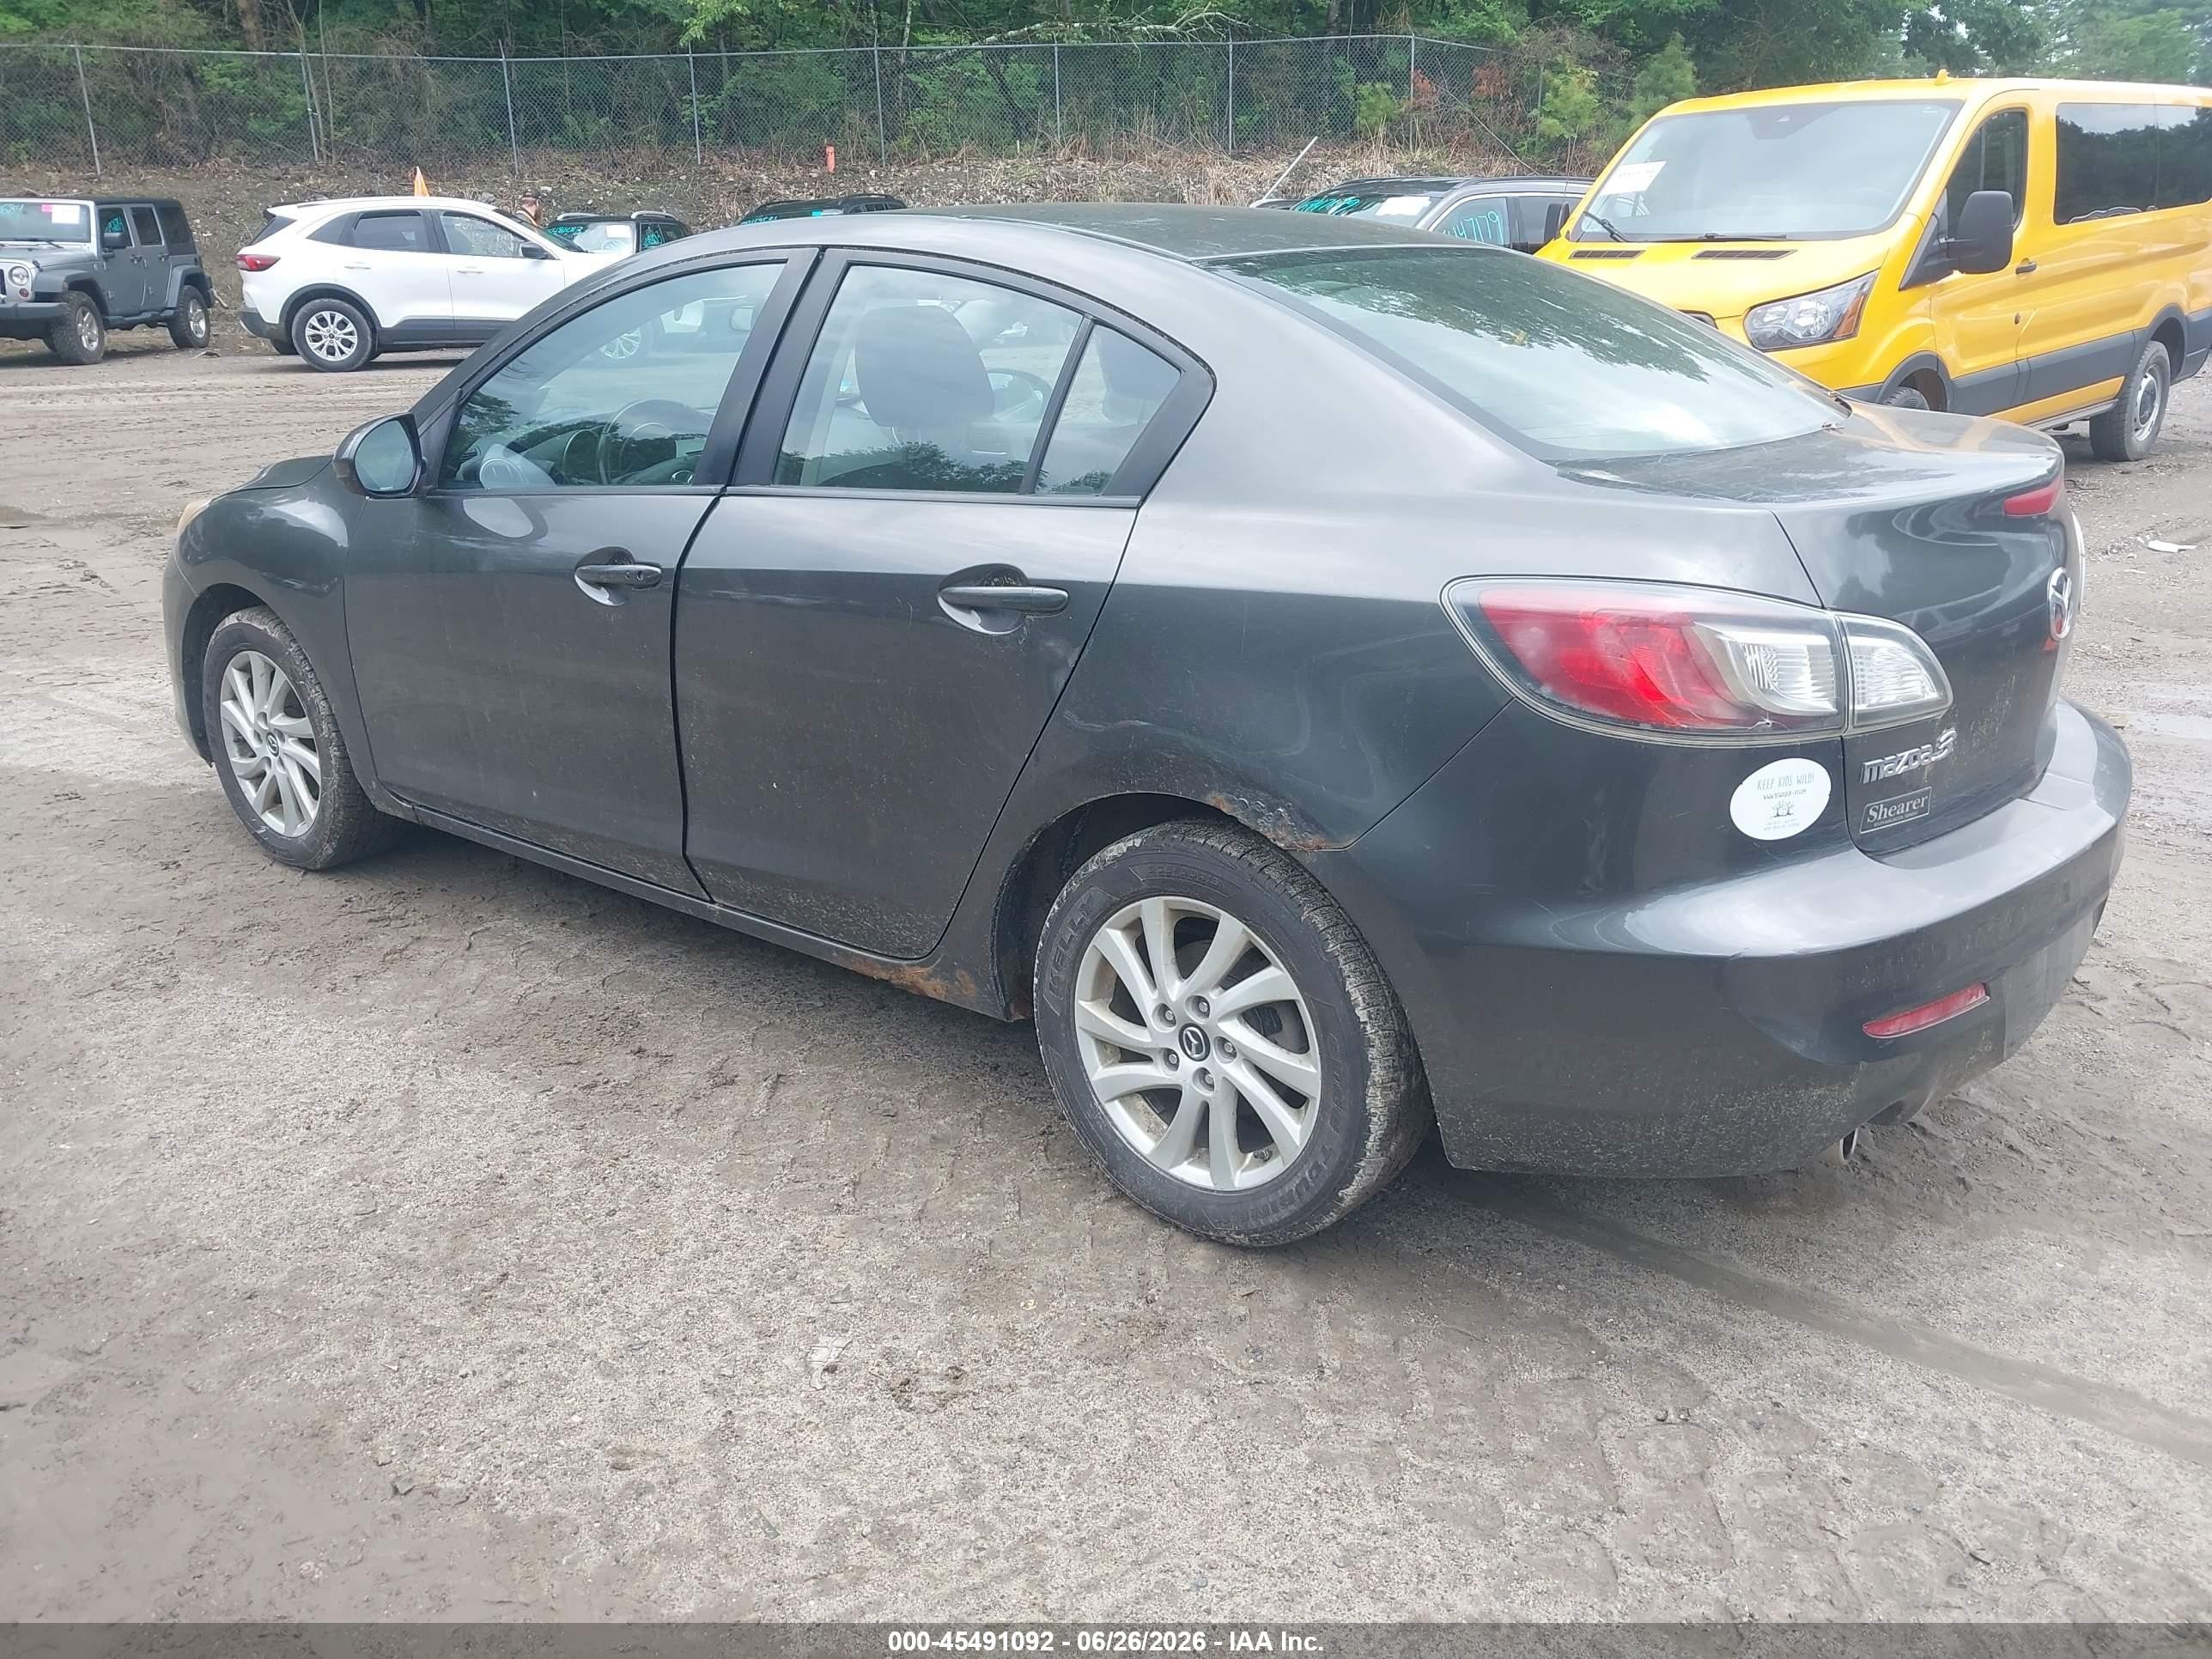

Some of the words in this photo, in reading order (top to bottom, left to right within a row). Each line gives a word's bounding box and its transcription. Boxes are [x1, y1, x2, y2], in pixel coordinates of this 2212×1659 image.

[1757, 777, 1774, 791] KEEP
[1778, 775, 1794, 788] KIDS
[1867, 795, 1929, 824] Shearer
